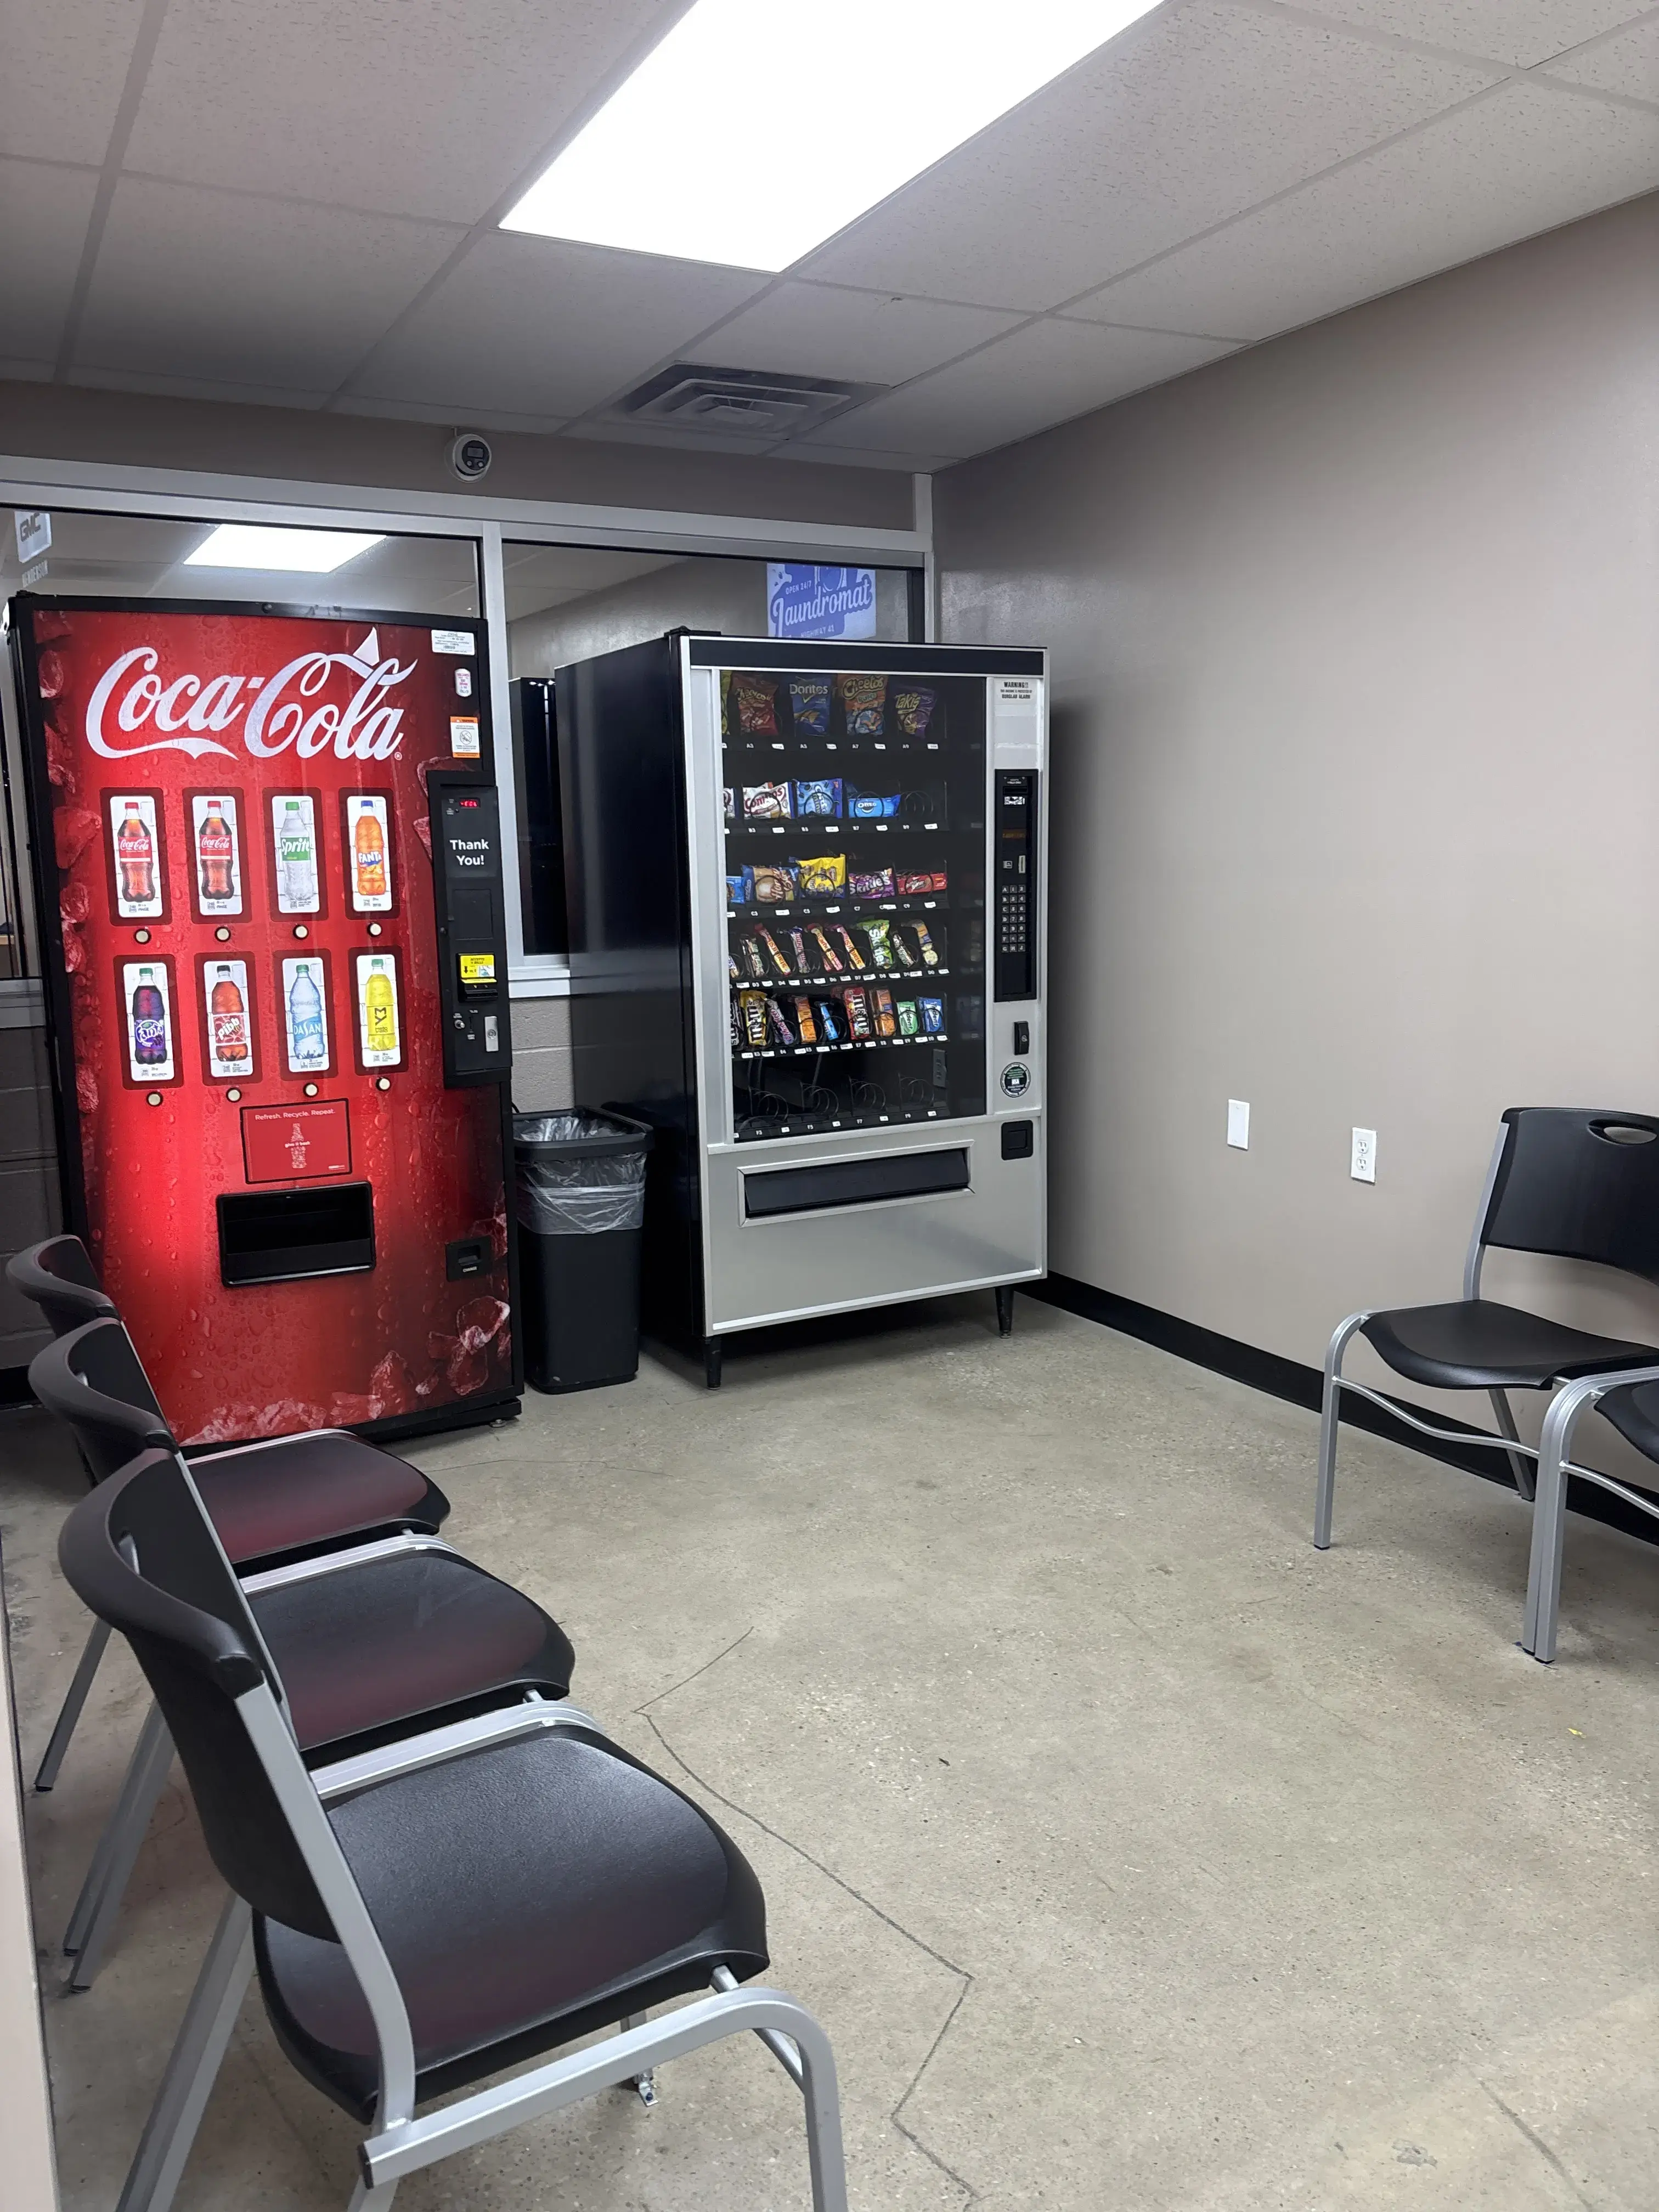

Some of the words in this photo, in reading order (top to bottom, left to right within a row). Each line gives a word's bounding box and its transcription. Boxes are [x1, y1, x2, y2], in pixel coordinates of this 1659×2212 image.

[786, 585, 799, 595] OPEN
[800, 580, 812, 591] 24/7
[85, 627, 418, 761] Coca-Cola
[789, 684, 828, 695] Doritos
[843, 675, 883, 697] Cheetos
[894, 692, 921, 709] Takis
[449, 839, 489, 850] Thank
[358, 852, 382, 864] FANTA
[456, 855, 484, 866] You!
[849, 877, 891, 894] Skittles
[930, 1002, 939, 1026] Trdent
[138, 1023, 163, 1041] Fanta
[217, 1017, 242, 1040] Pibb
[292, 1017, 321, 1037] DASAN
